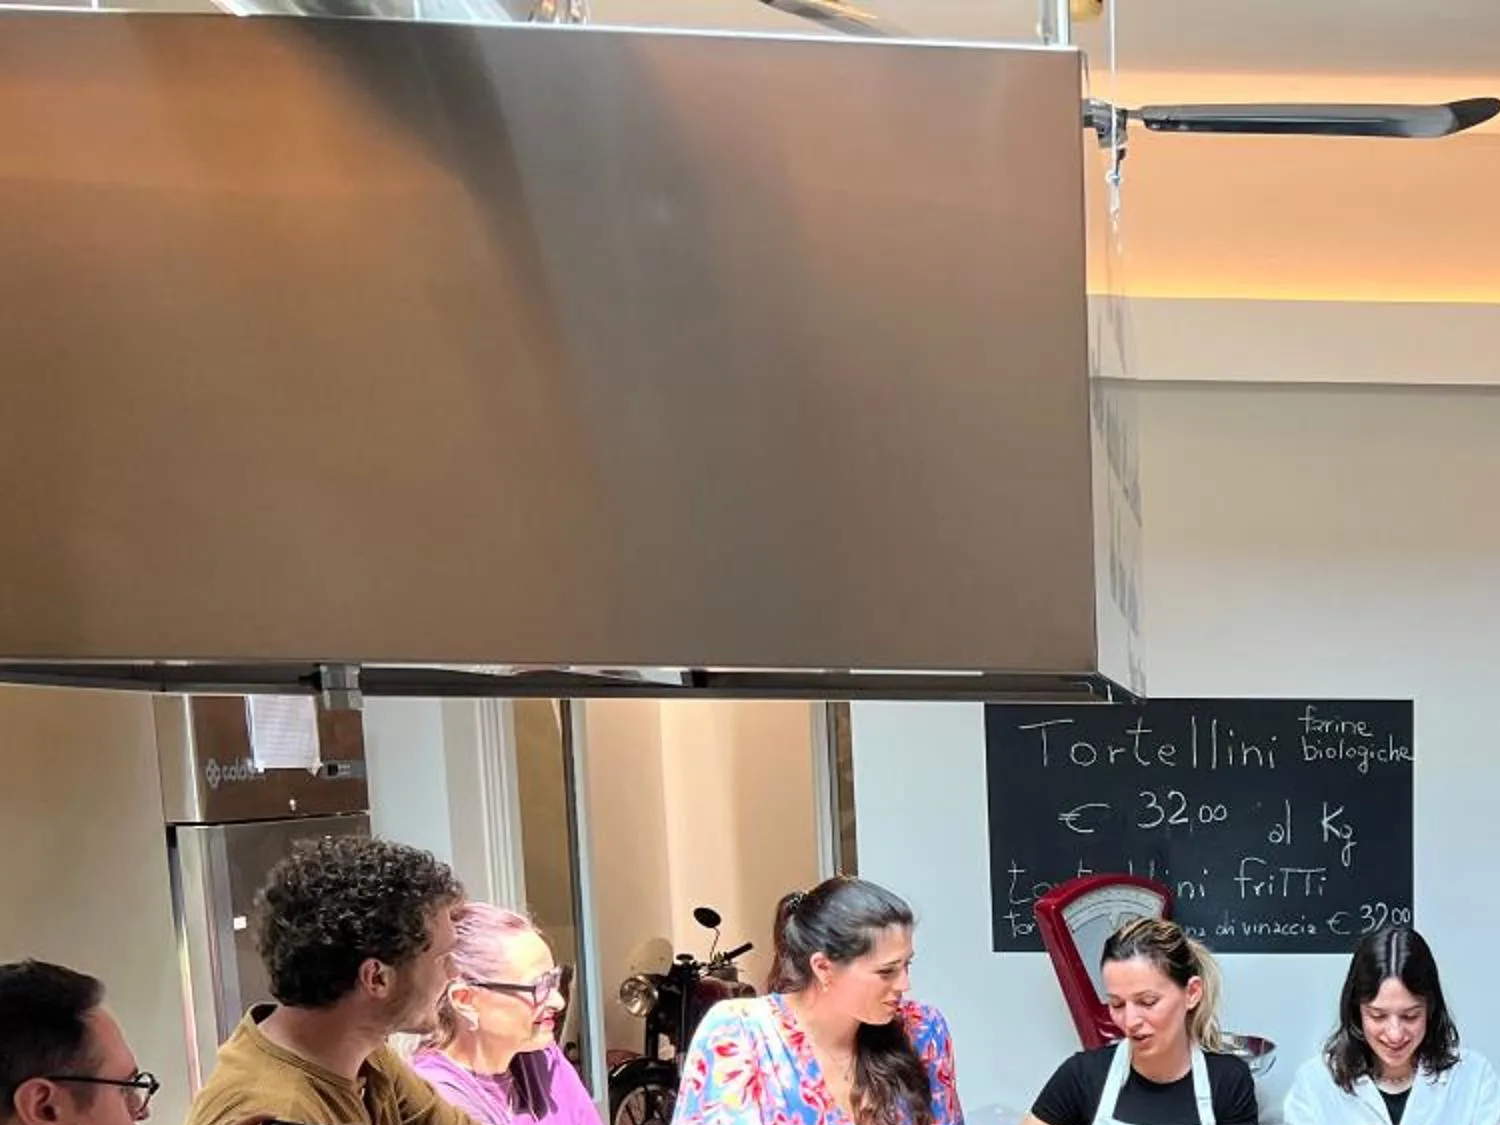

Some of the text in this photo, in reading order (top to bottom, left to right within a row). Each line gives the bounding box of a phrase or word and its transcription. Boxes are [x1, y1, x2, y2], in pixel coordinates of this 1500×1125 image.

[1298, 704, 1374, 736] farine
[1018, 715, 1277, 770] Tortellini
[1301, 734, 1416, 774] biologiche
[1057, 803, 1111, 833] €
[1268, 799, 1291, 844] al
[1321, 802, 1357, 867] Kg
[1242, 914, 1317, 936] vinaccia
[1326, 911, 1352, 935] €
